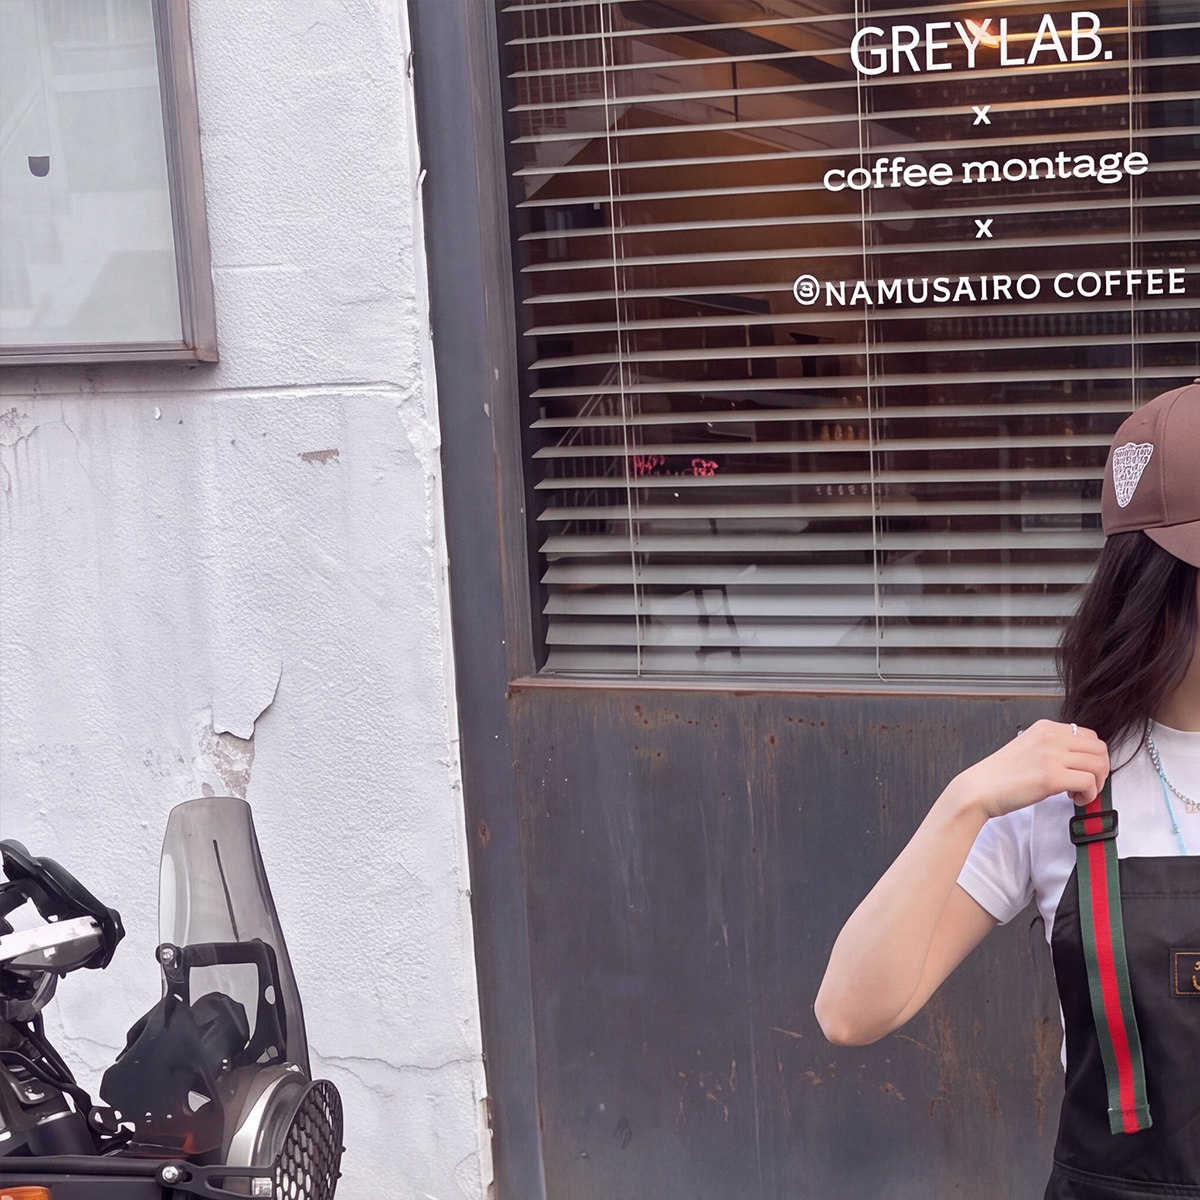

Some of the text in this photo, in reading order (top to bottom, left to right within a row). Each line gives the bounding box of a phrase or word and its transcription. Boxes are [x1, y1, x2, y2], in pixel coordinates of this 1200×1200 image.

[822, 151, 1150, 193] coffee montage
[1053, 267, 1187, 299] COFFEE
